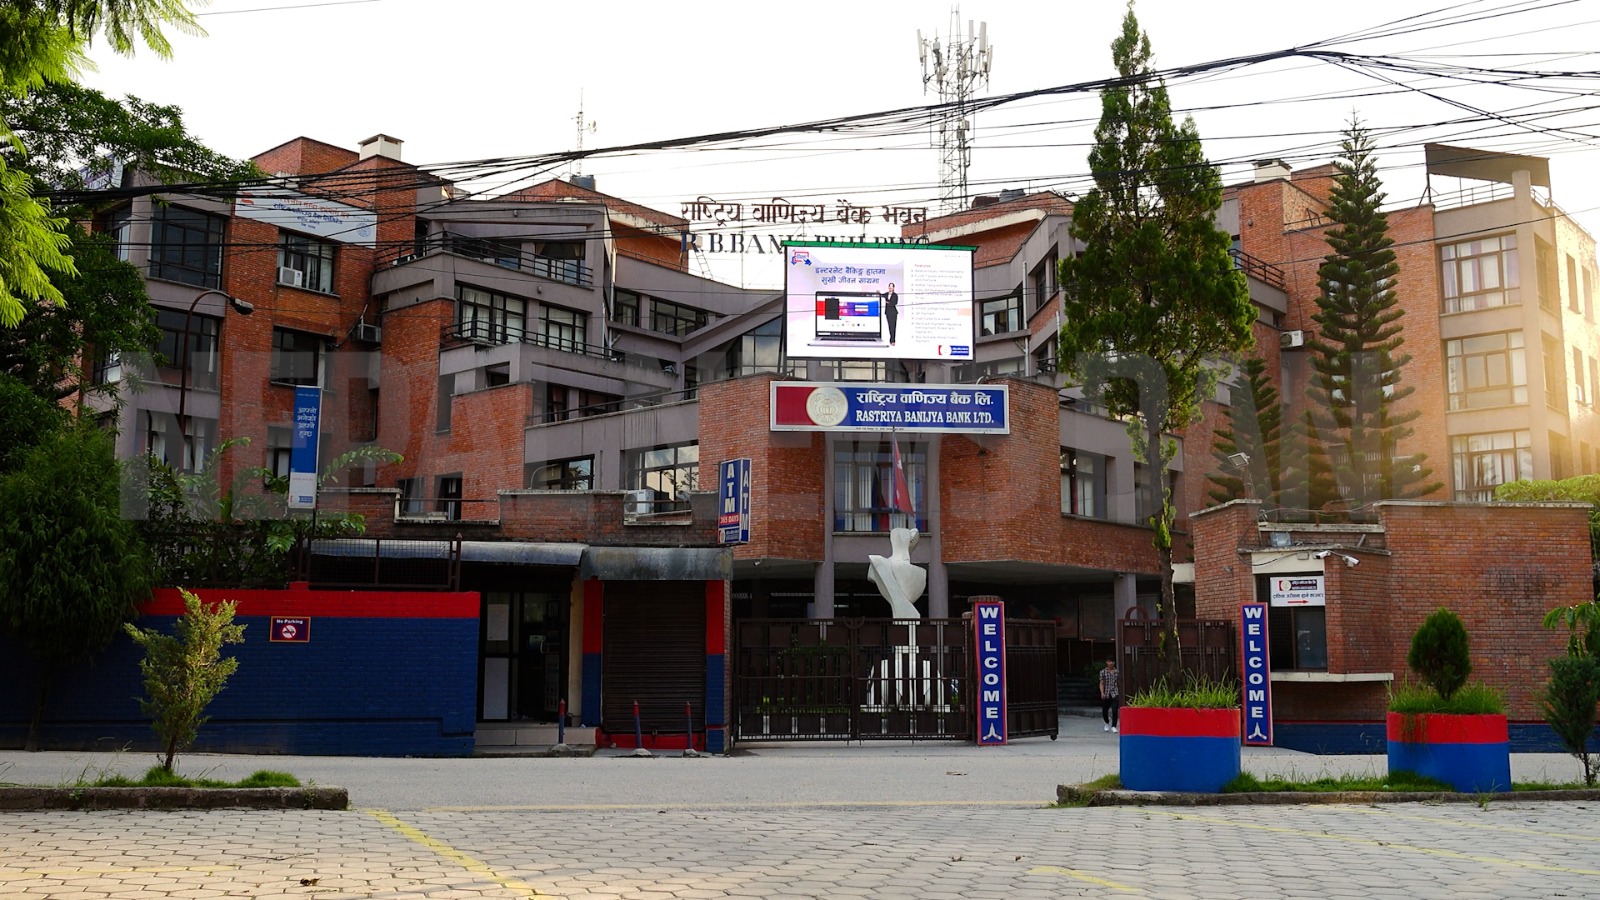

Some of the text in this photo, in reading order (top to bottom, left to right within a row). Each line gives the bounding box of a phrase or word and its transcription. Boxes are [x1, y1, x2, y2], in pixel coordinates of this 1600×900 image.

[752, 197, 825, 223] वाणिज्य
[882, 205, 928, 225] भवन
[856, 390, 896, 406] राष्ट्रिय
[900, 391, 946, 405] वाणिज्य
[950, 391, 971, 405] बैंक
[856, 410, 994, 424] RASTRIYA BANIJYA BANK LTD.
[724, 463, 736, 513] ATM
[720, 514, 739, 524] 365 DAYS
[980, 607, 1000, 719] WELCOME
[1244, 607, 1265, 718] WELCOME
